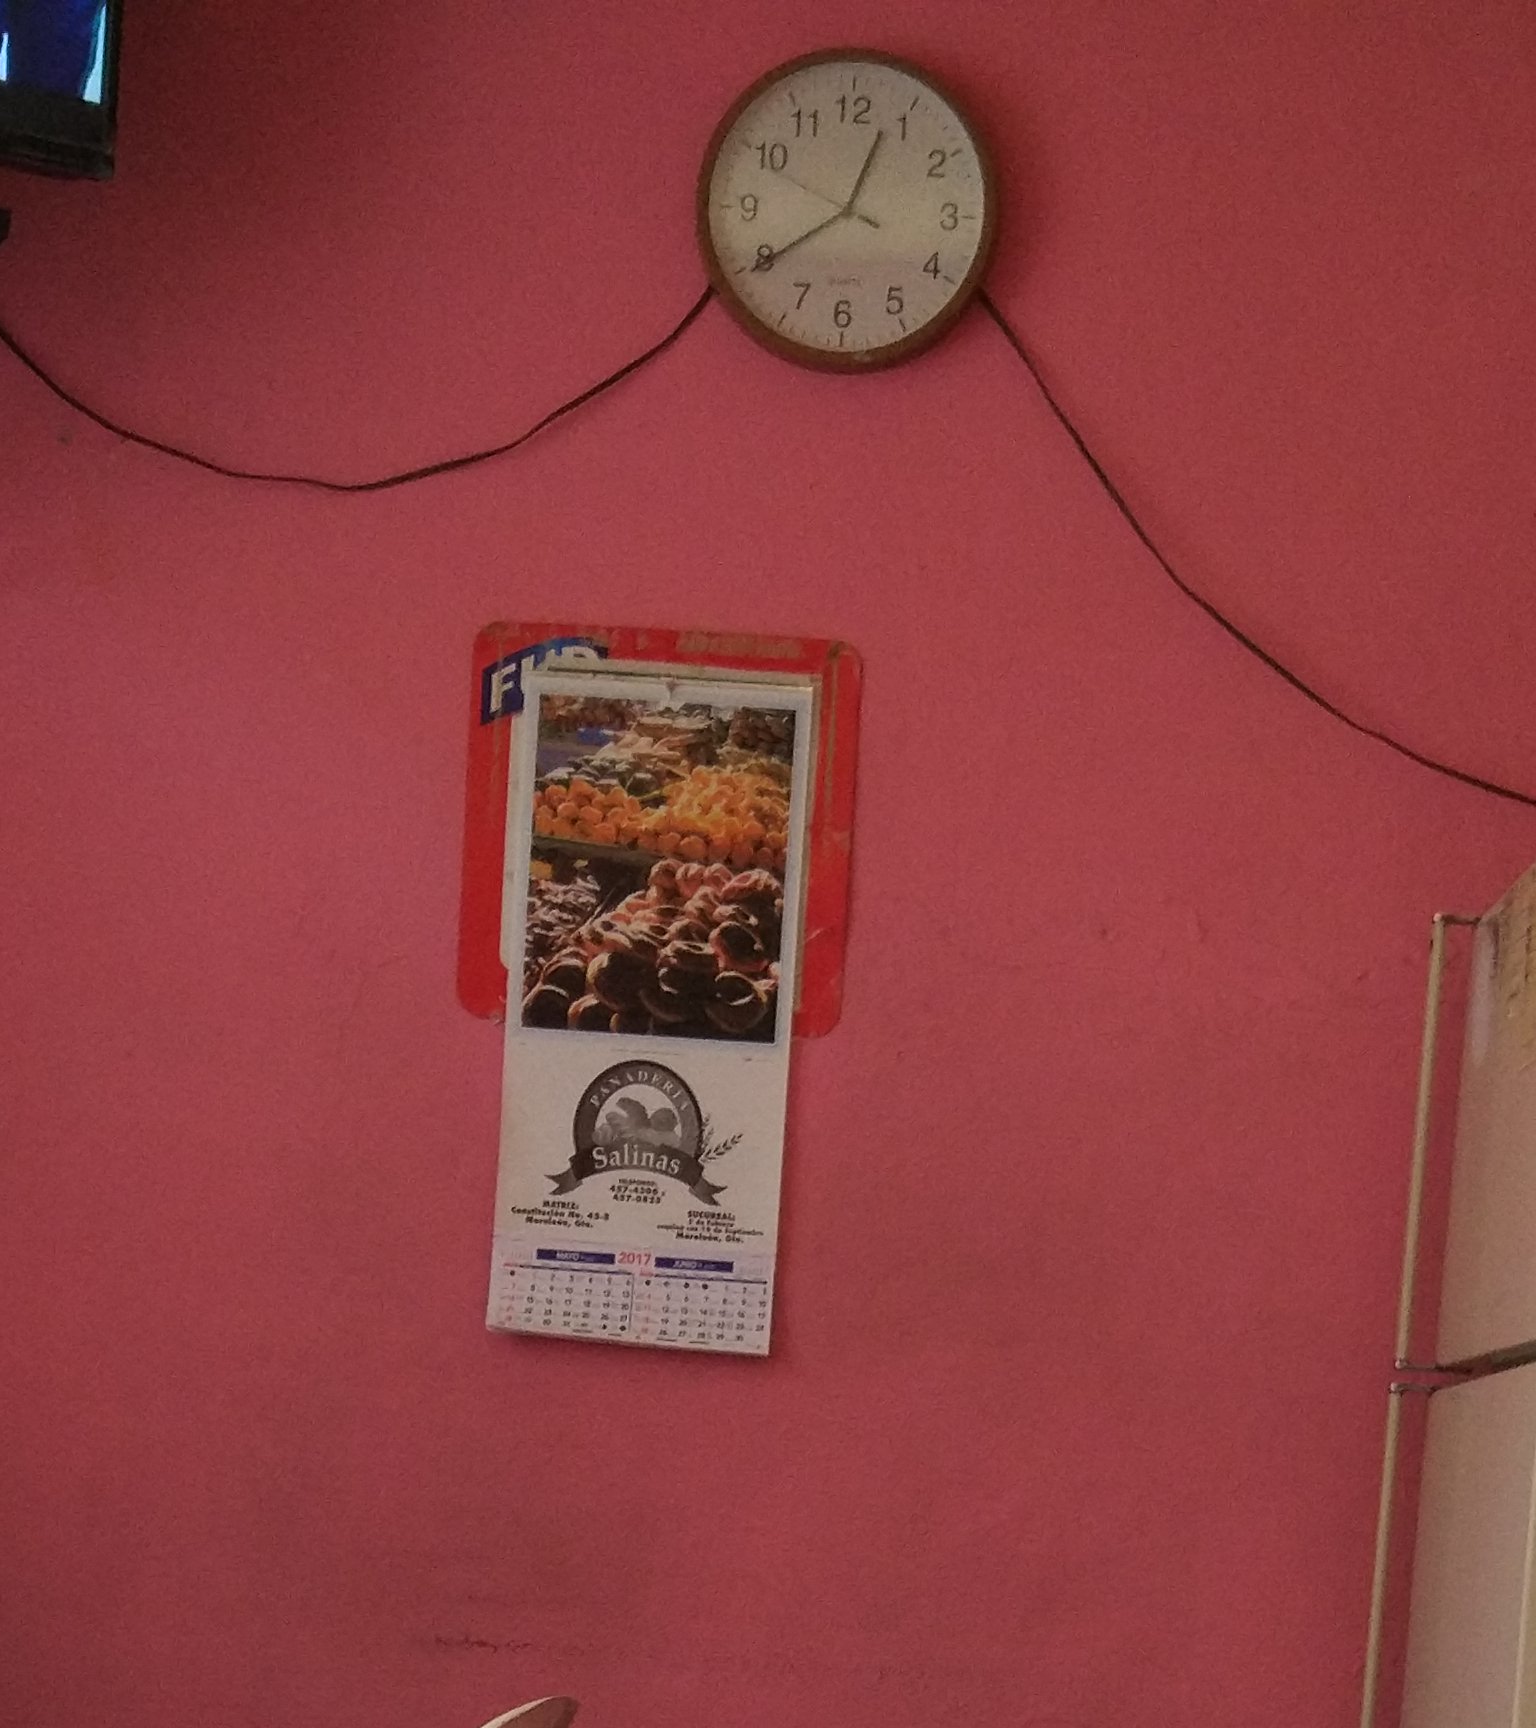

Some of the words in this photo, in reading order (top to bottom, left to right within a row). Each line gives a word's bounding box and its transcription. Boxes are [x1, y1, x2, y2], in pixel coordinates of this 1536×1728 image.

[791, 109, 820, 138] 11
[835, 95, 872, 125] 12
[897, 115, 908, 141] 1
[755, 141, 788, 171] 10
[926, 148, 946, 178] 2
[740, 193, 759, 221] 9
[939, 202, 959, 231] 3
[755, 243, 774, 272] 8
[922, 251, 941, 280] 4
[792, 281, 812, 310] 7
[885, 286, 904, 314] 5
[833, 299, 852, 329] 6
[591, 1142, 681, 1175] Salinas
[617, 1252, 651, 1266] 2017
